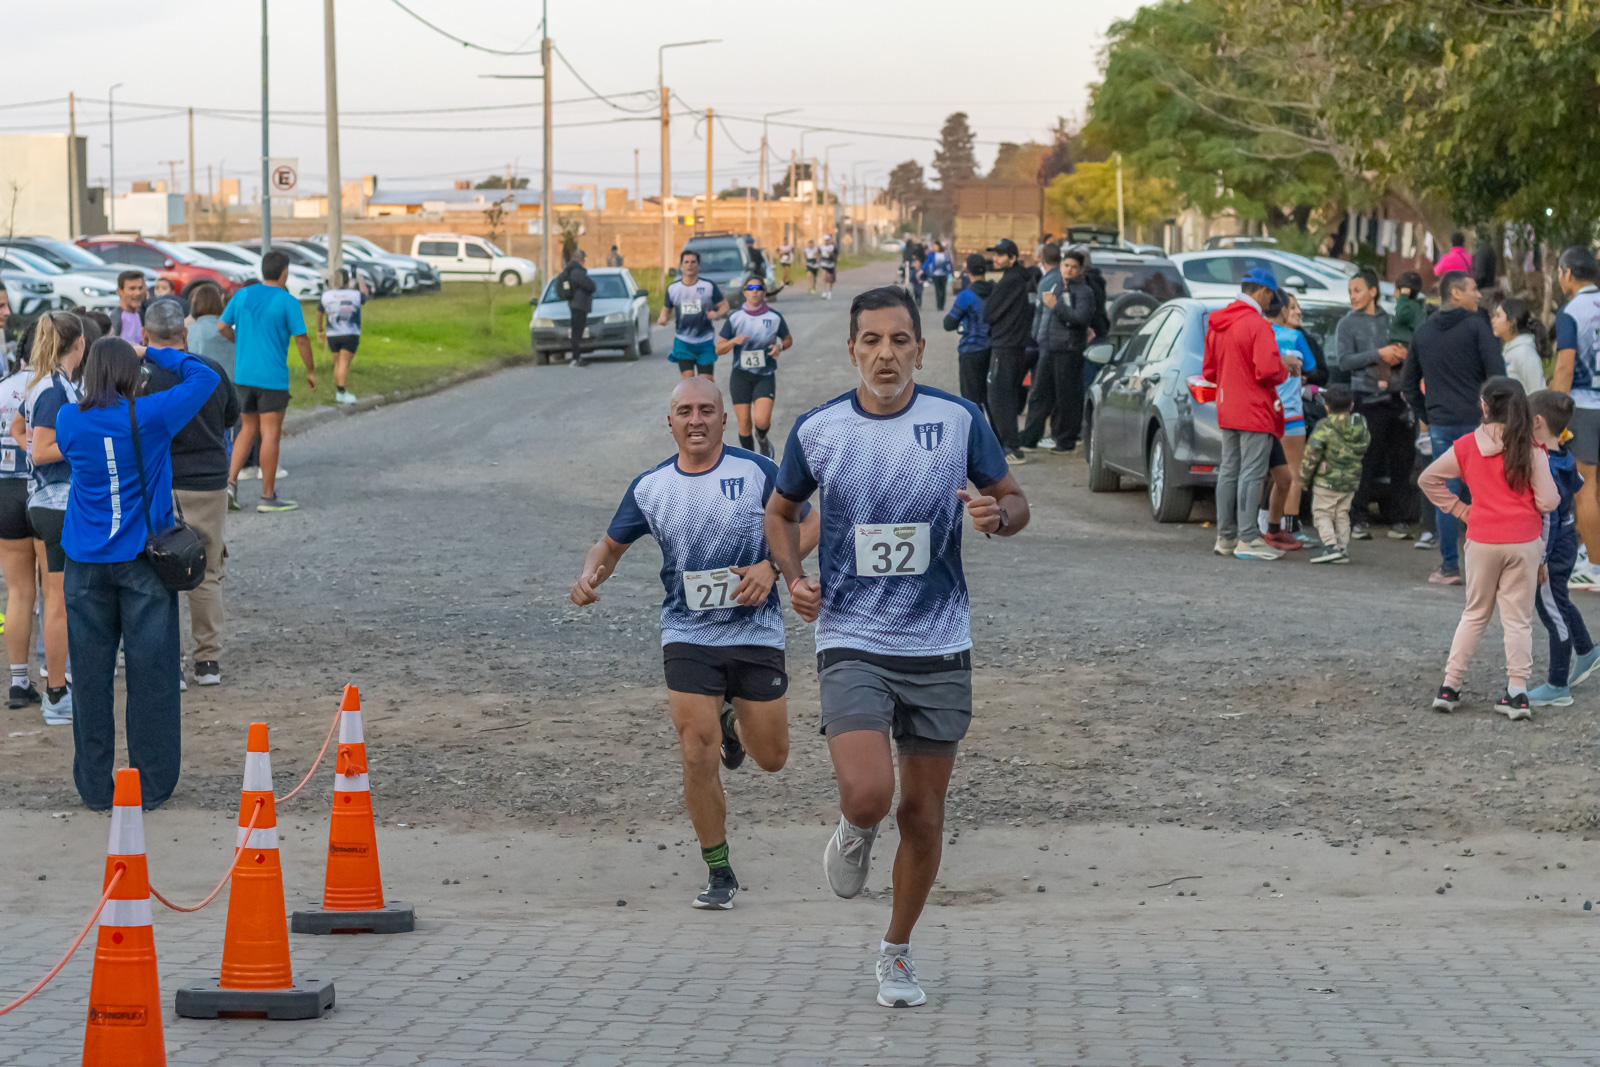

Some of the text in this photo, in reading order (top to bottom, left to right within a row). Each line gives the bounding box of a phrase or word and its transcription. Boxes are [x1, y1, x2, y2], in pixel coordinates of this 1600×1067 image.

[278, 171, 290, 185] E
[745, 356, 760, 367] 43
[919, 424, 939, 433] SFC
[872, 541, 916, 574] 32
[696, 582, 728, 608] 27
